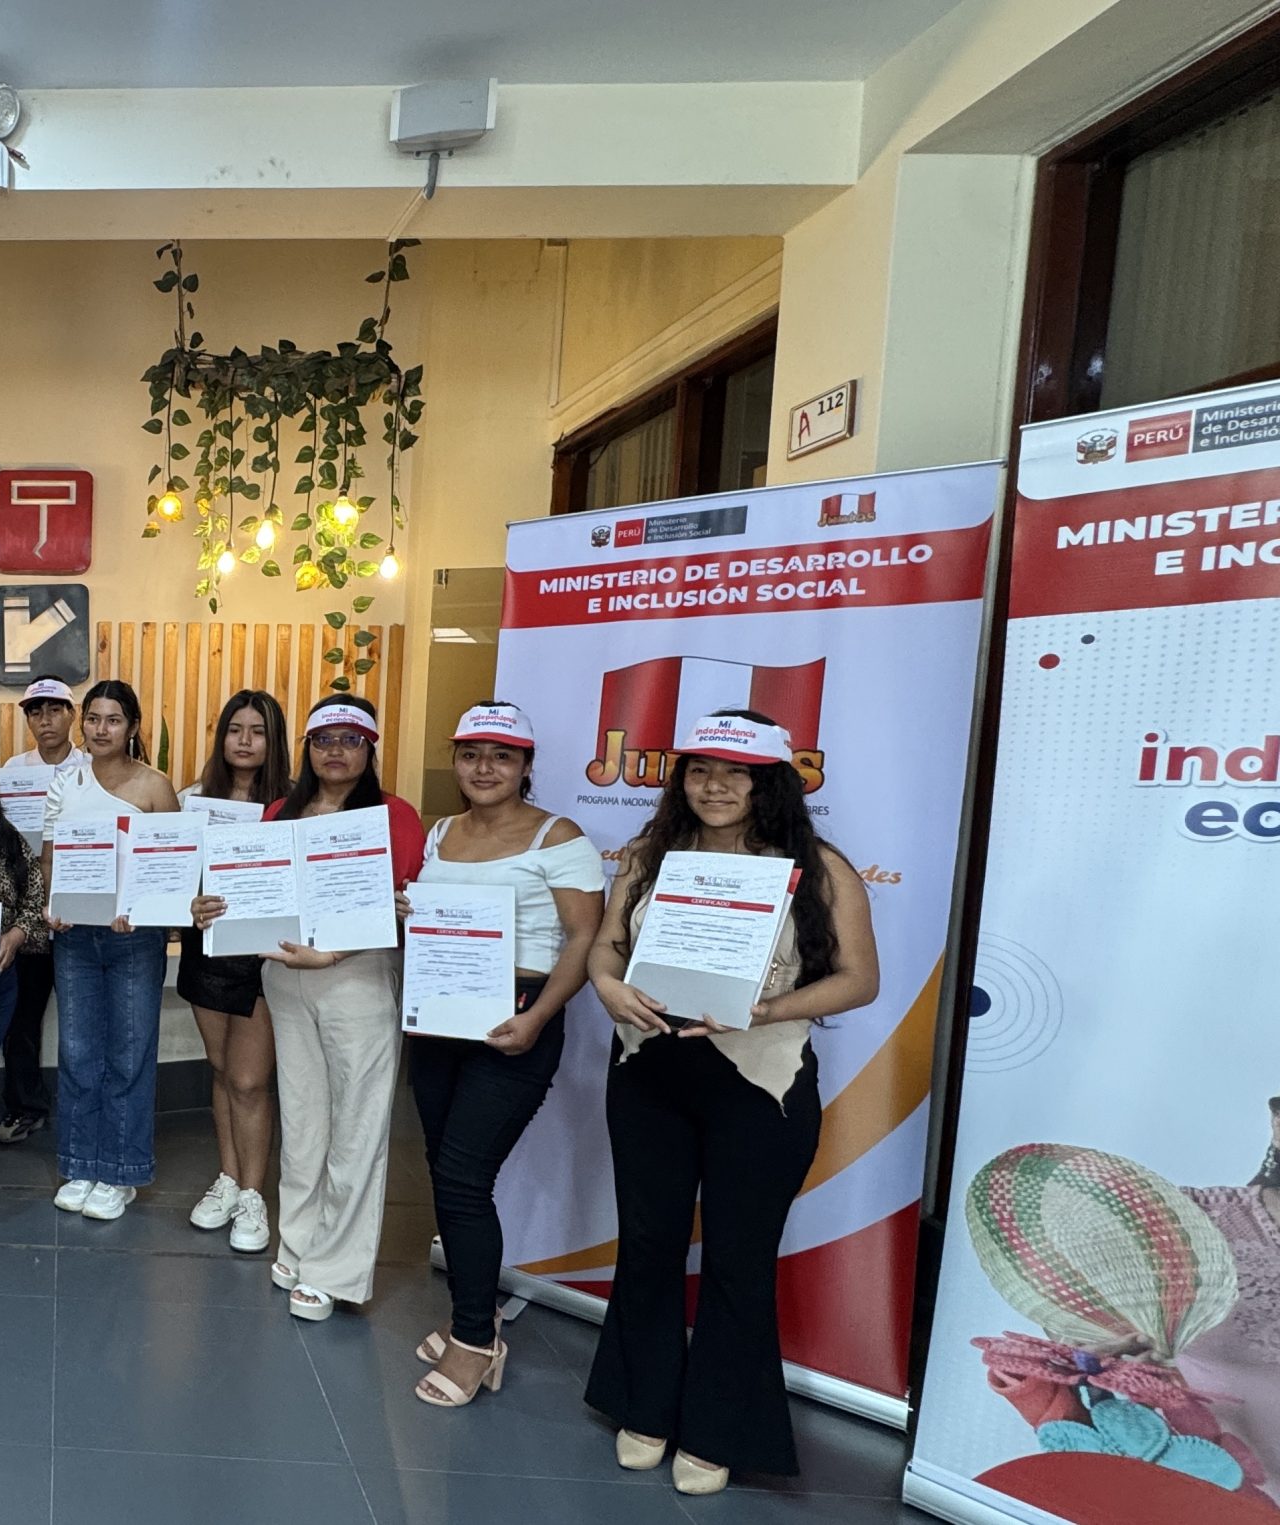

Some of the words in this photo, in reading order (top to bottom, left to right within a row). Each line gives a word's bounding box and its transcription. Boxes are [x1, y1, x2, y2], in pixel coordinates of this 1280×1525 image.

[798, 409, 811, 447] A
[817, 391, 844, 416] 112
[1202, 400, 1280, 423] Ministeri
[1201, 423, 1223, 435] de
[1227, 415, 1280, 431] Desarr
[1133, 425, 1184, 447] PERÚ
[1199, 438, 1210, 447] e
[1214, 425, 1280, 445] Inclusió
[648, 517, 688, 527] Ministerio
[659, 522, 699, 533] Desarrollo
[617, 527, 641, 539] PERÚ
[653, 530, 688, 541] Inclusión
[689, 527, 712, 538] Social
[1154, 549, 1185, 576] E
[1200, 541, 1280, 571] INC
[539, 567, 677, 594] MINISTERIO
[684, 562, 721, 582] DE
[728, 544, 934, 578] DESARROLLO
[587, 597, 602, 614] E
[608, 582, 748, 612] INCLUSIÓN
[756, 577, 866, 601] SOCIAL
[695, 727, 757, 738] independencia
[718, 720, 732, 728] Mi
[698, 734, 749, 745] económica
[1139, 732, 1280, 782] ind
[577, 795, 619, 805] PROGRAMA
[691, 898, 731, 908] CERTIFICADO
